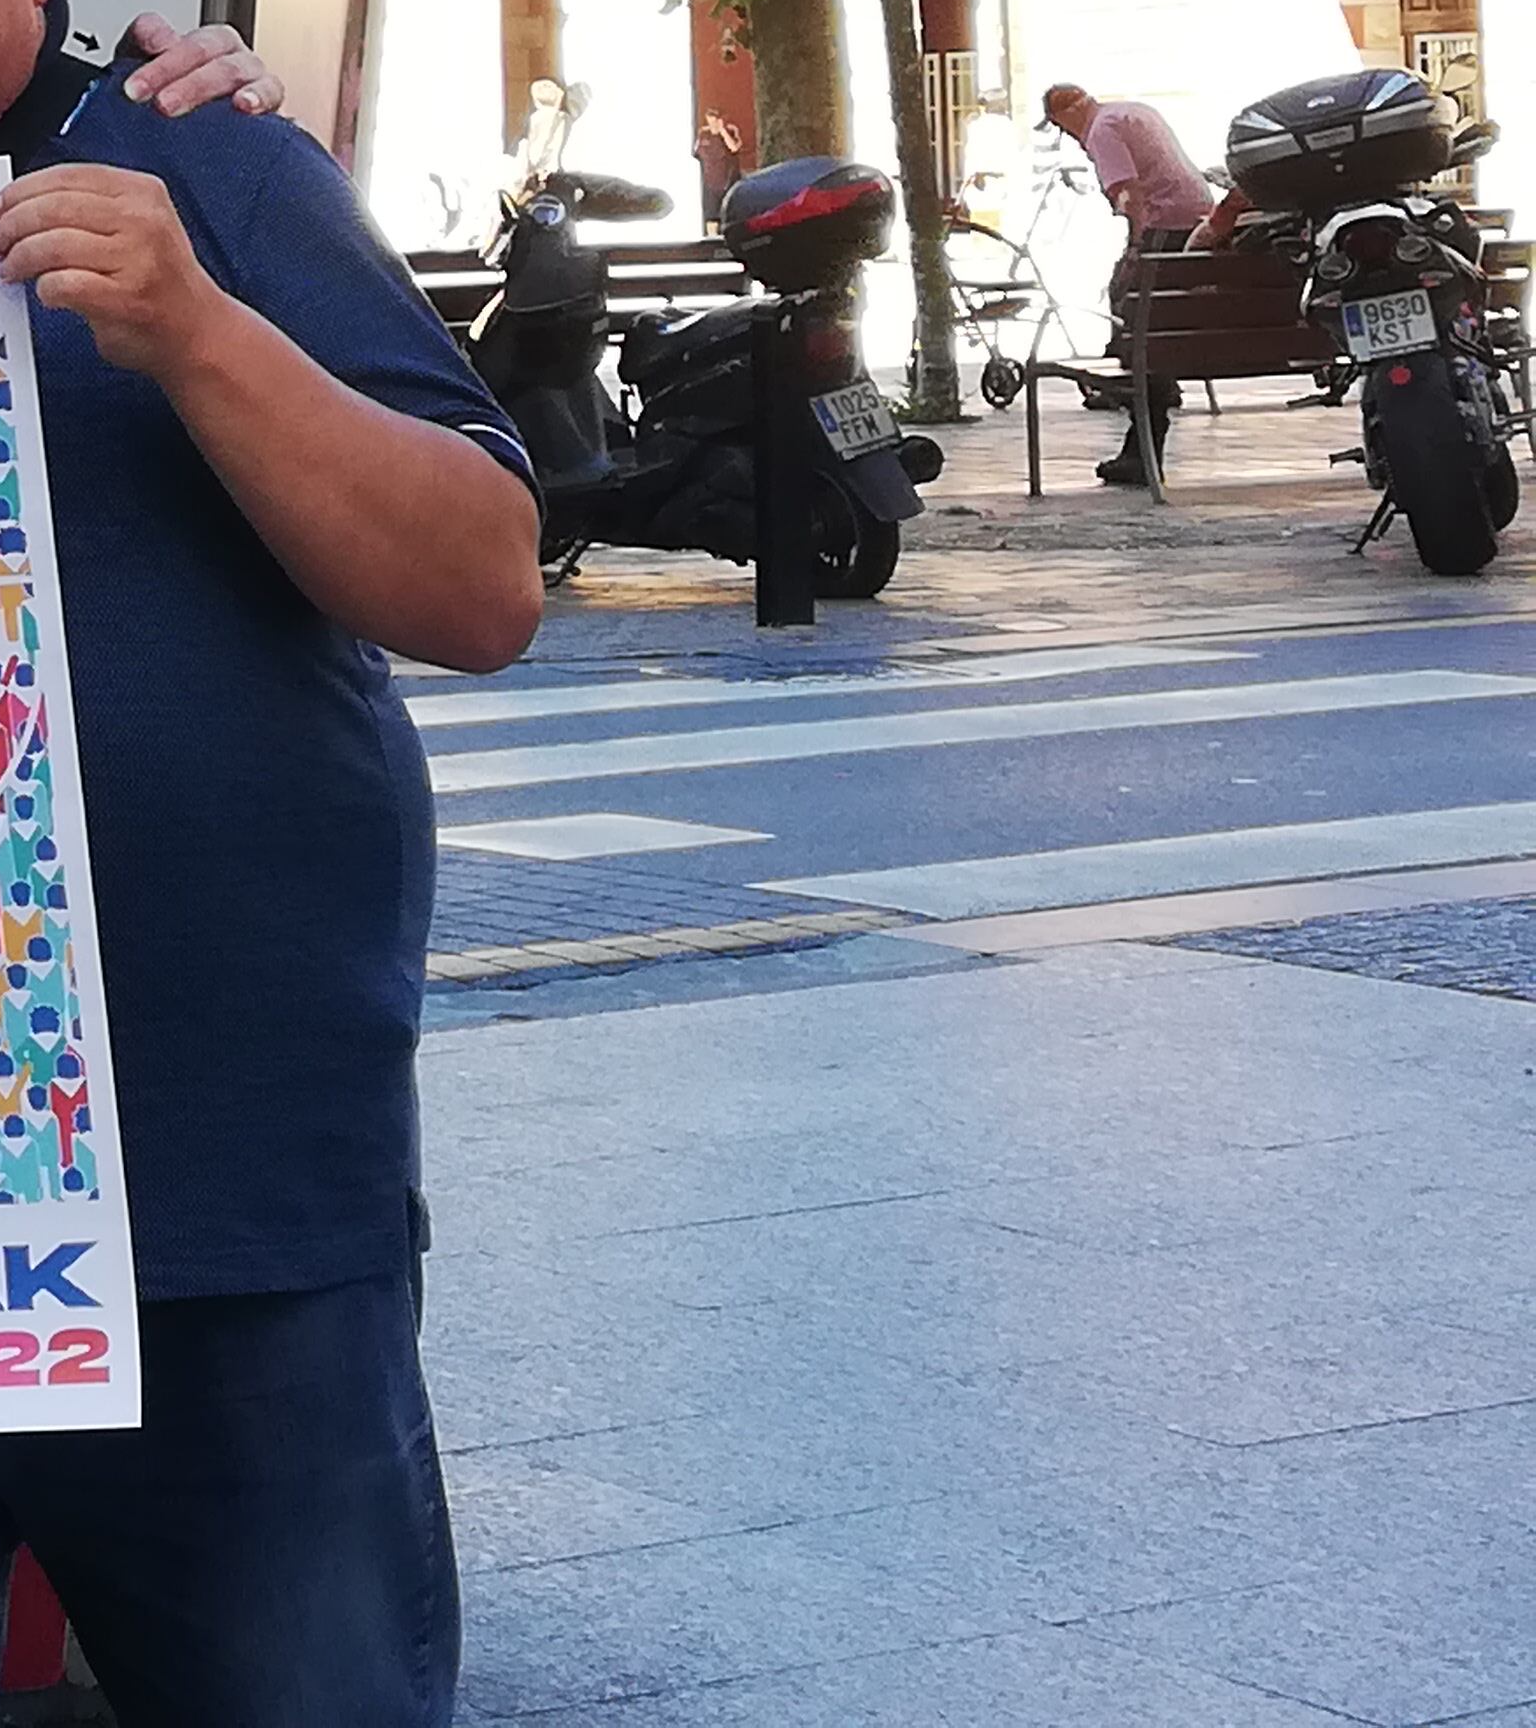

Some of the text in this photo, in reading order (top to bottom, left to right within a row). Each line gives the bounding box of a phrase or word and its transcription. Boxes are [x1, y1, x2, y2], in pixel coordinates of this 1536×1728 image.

[1363, 293, 1427, 324] 9630
[1368, 319, 1414, 348] KST
[830, 385, 879, 420] 1025
